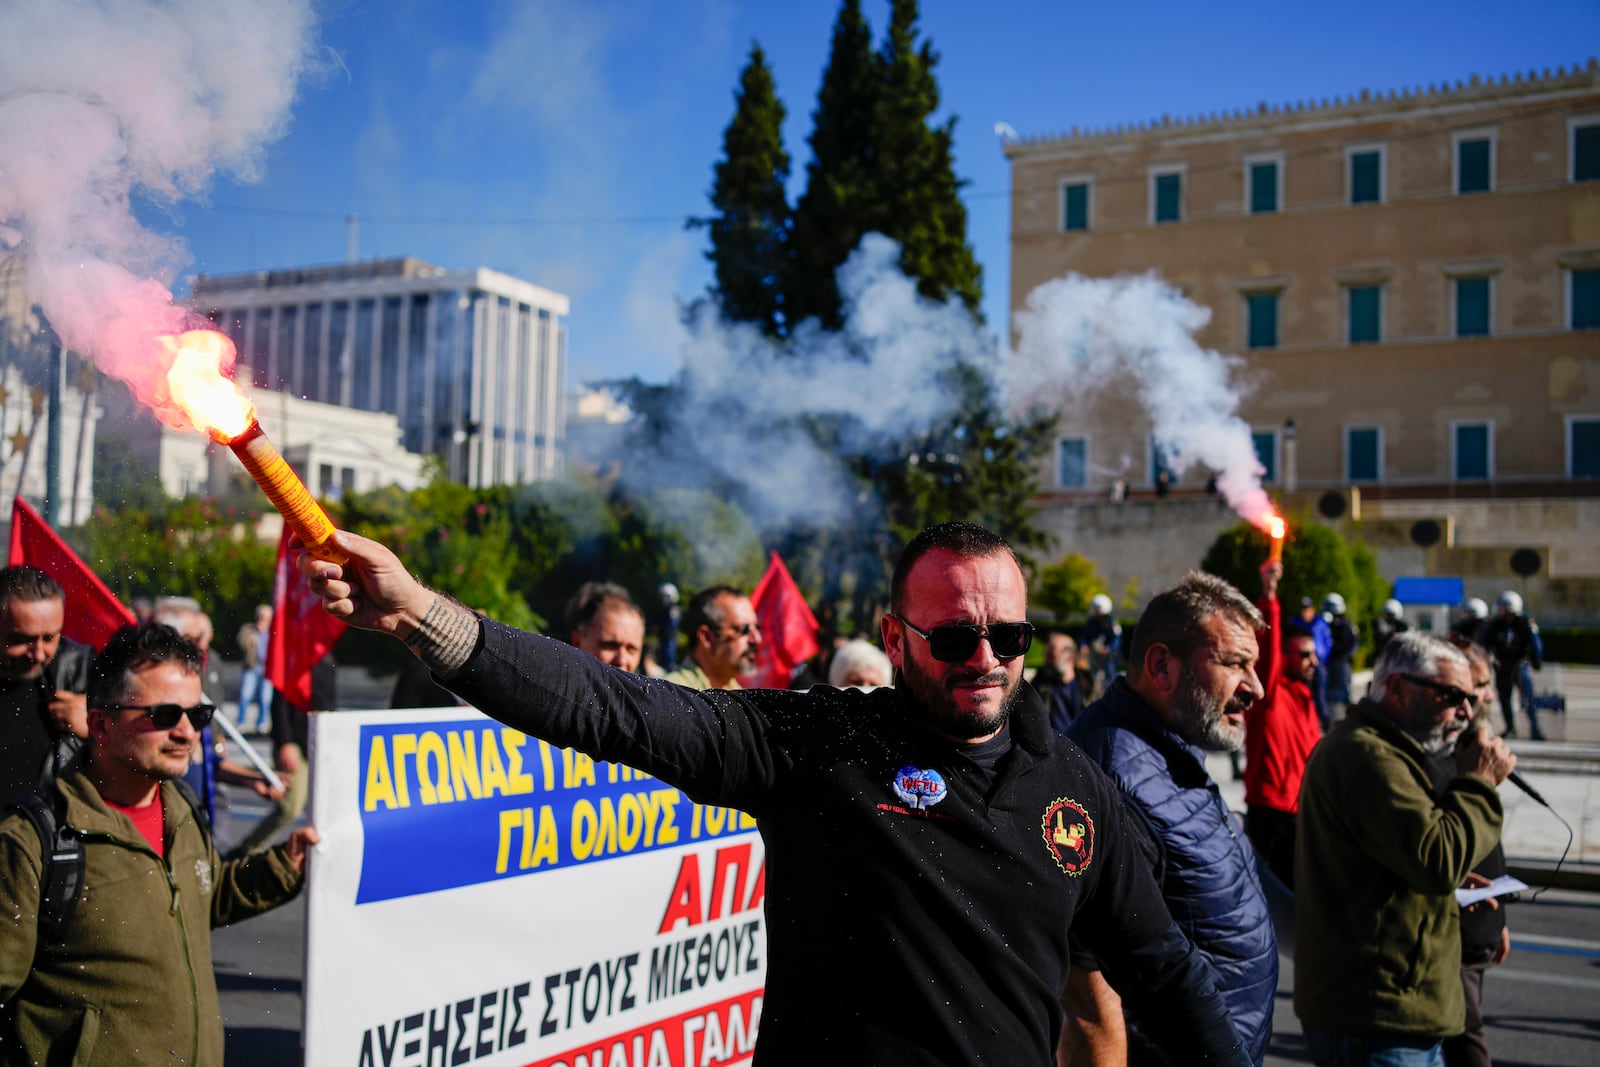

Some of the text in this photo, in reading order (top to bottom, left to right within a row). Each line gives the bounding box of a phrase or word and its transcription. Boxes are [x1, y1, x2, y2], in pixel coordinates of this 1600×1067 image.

[364, 728, 533, 813] ΑΓΩΝΑΣ
[902, 776, 939, 793] WFTU
[496, 804, 560, 875] ΓΙΑ
[571, 788, 681, 860] ΟΛΟΥΣ
[357, 982, 531, 1067] ΑΥΞΗΣΕΙΣ
[539, 952, 640, 1038] ΣΤΟΥΣ
[648, 920, 760, 1004] ΜΙΣΘΟΥΣ
